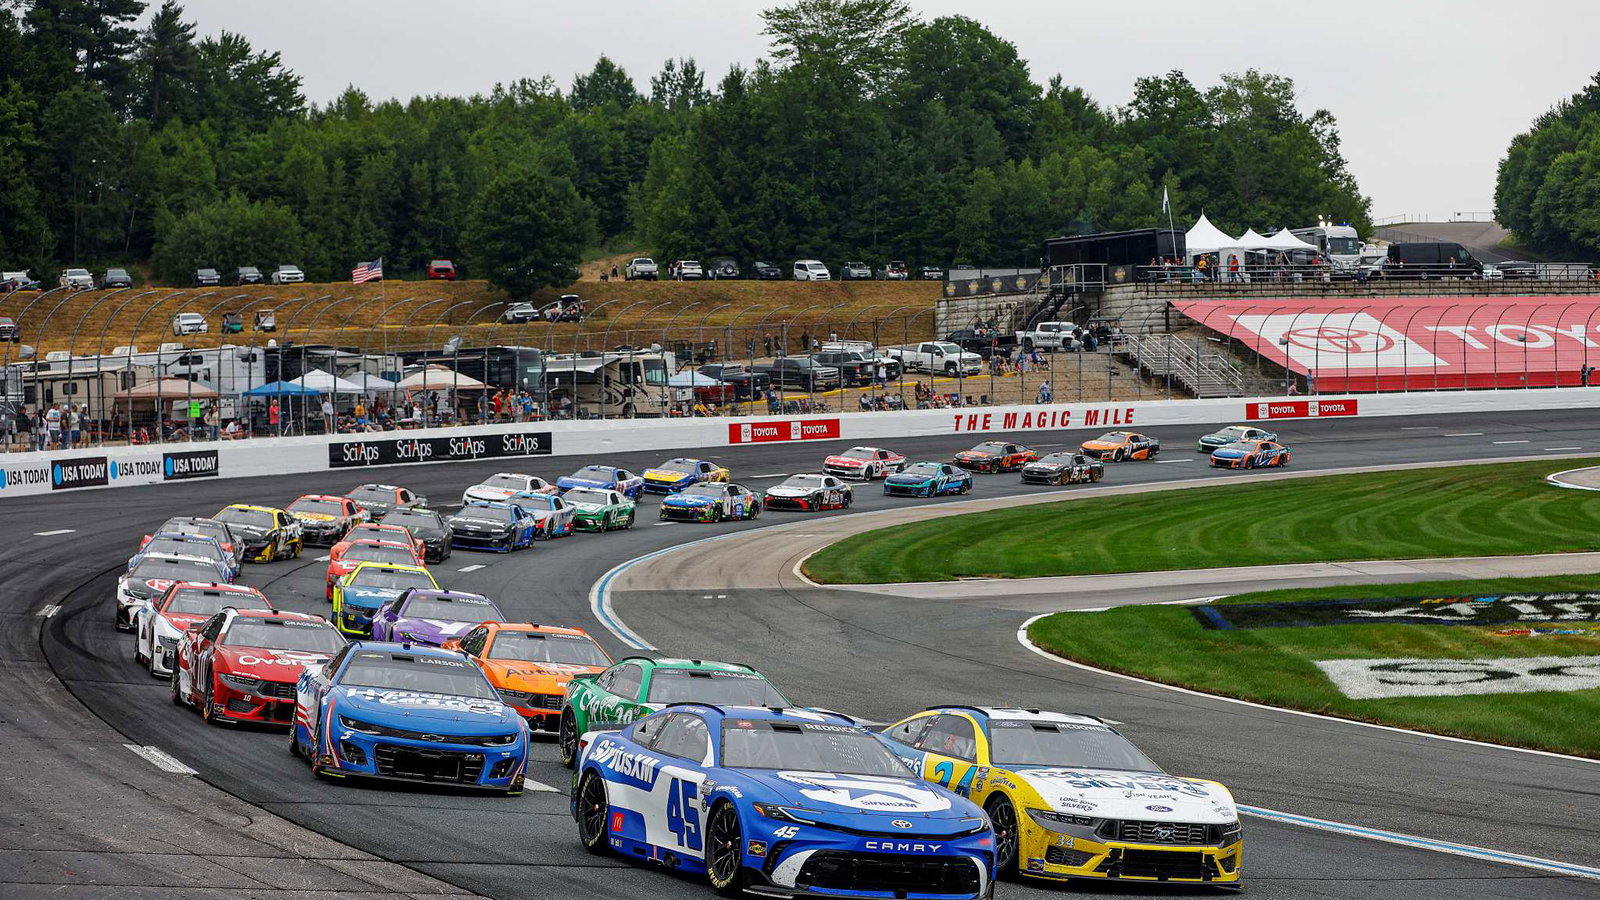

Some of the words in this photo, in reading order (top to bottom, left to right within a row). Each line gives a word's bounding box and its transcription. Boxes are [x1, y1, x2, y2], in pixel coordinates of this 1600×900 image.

[1424, 324, 1600, 350] TOY
[1270, 406, 1296, 414] TOYOTA
[1320, 404, 1346, 412] TOYOTA
[954, 414, 992, 431] THE
[1003, 410, 1071, 428] MAGIC
[1084, 408, 1135, 425] MILE
[752, 428, 779, 437] TOYOTA
[802, 425, 828, 434] TOYOTA
[396, 440, 432, 461] SciAps
[449, 437, 486, 458] SciAps
[502, 434, 539, 454] SciAps
[343, 442, 380, 465] SciAps
[118, 463, 135, 476] USA
[134, 461, 161, 475] TODAY
[173, 458, 190, 471] USA
[190, 456, 217, 470] TODAY
[6, 471, 24, 486] USA
[23, 468, 50, 484] TODAY
[61, 466, 79, 481] USA
[79, 463, 106, 479] TODAY
[420, 658, 464, 668] LARSON
[804, 723, 862, 735] REDDICK
[589, 739, 660, 783] SiriusXM
[1059, 796, 1079, 804] LONG
[1080, 799, 1098, 808] JOHN
[1061, 801, 1093, 812] SILVER'S
[667, 777, 703, 851] 45
[773, 826, 800, 839] 45
[865, 841, 942, 853] CAMRY
[1055, 835, 1074, 848] 34
